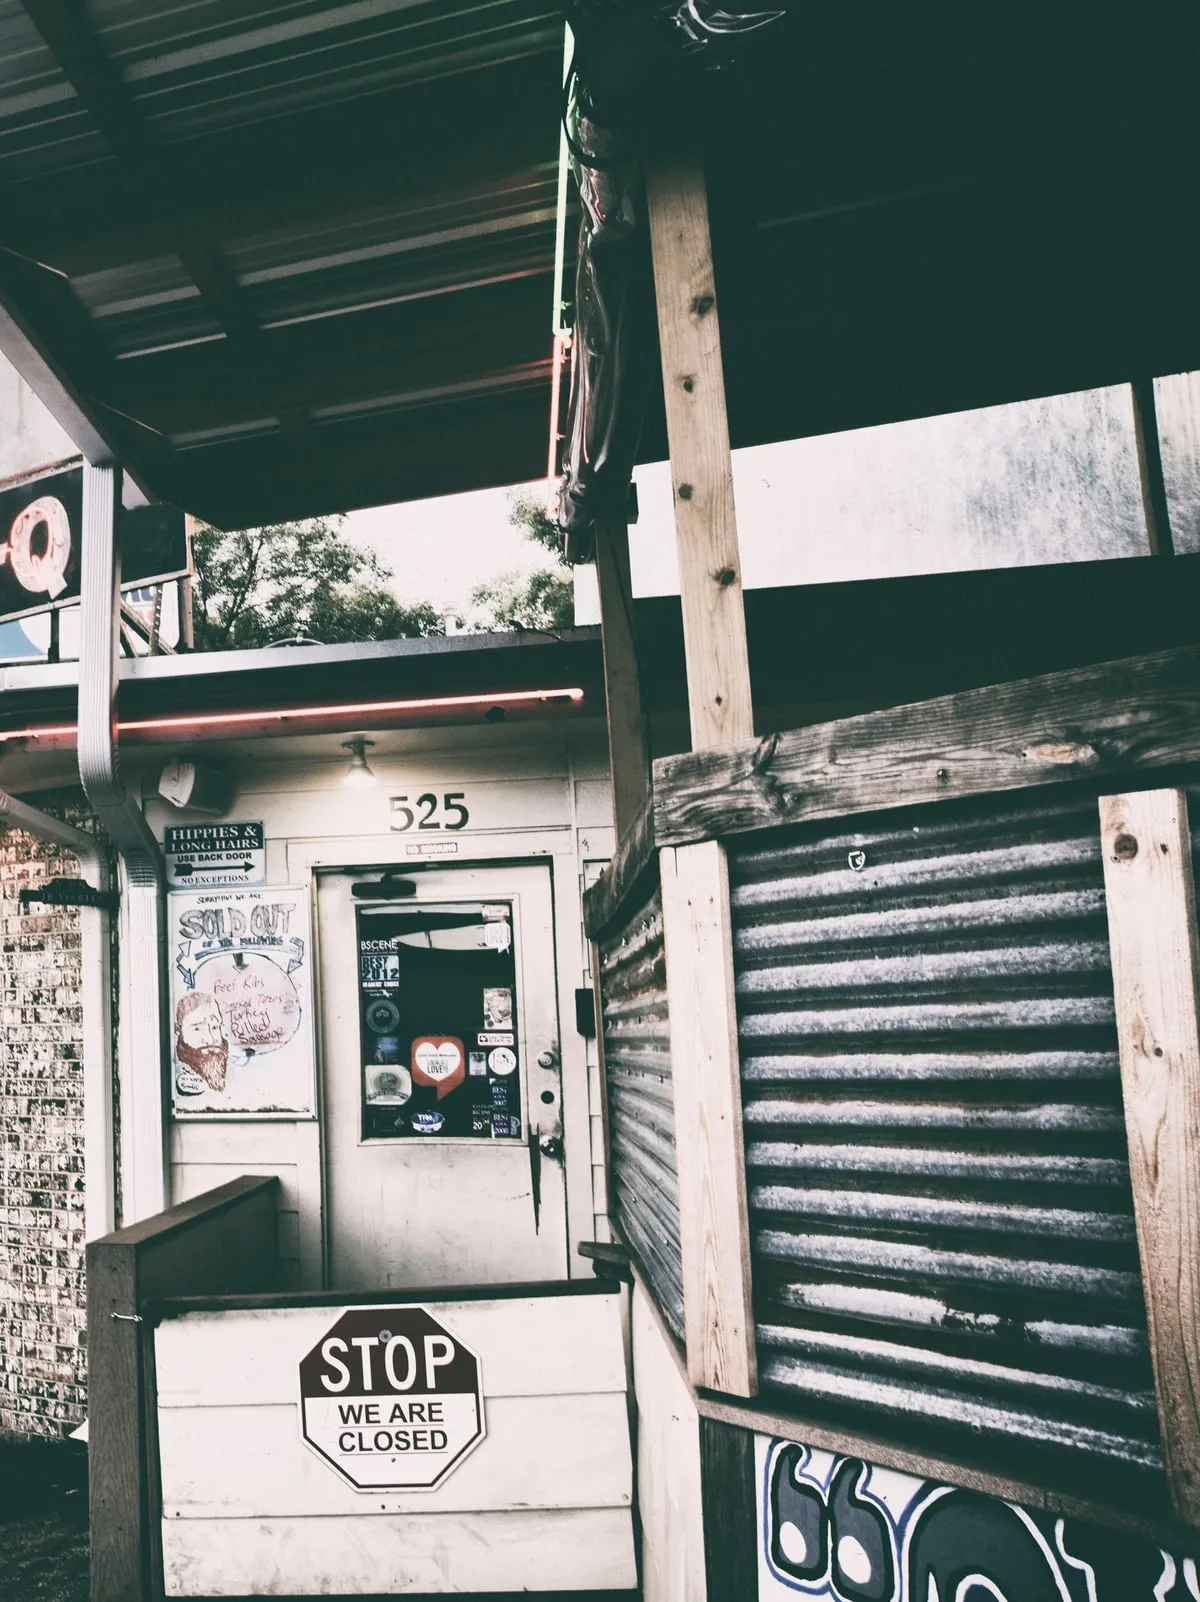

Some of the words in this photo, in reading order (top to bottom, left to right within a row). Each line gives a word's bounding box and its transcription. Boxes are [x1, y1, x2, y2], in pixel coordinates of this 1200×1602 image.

[389, 793, 469, 832] 525
[172, 825, 239, 840] HIPPIES
[244, 824, 257, 837] &
[171, 840, 211, 851] LONG
[215, 838, 259, 849] HAIRS
[177, 854, 195, 862] USE
[226, 851, 252, 860] DOOR
[195, 874, 250, 883] EXCEPTIONS
[179, 907, 246, 940] SOLD
[250, 903, 297, 937] OUT
[362, 957, 388, 969] BEST
[362, 968, 399, 980] 2012
[320, 1335, 456, 1392] STOP
[338, 1403, 381, 1425] WE
[388, 1402, 444, 1424] ARE
[338, 1429, 448, 1453] CLOSED
